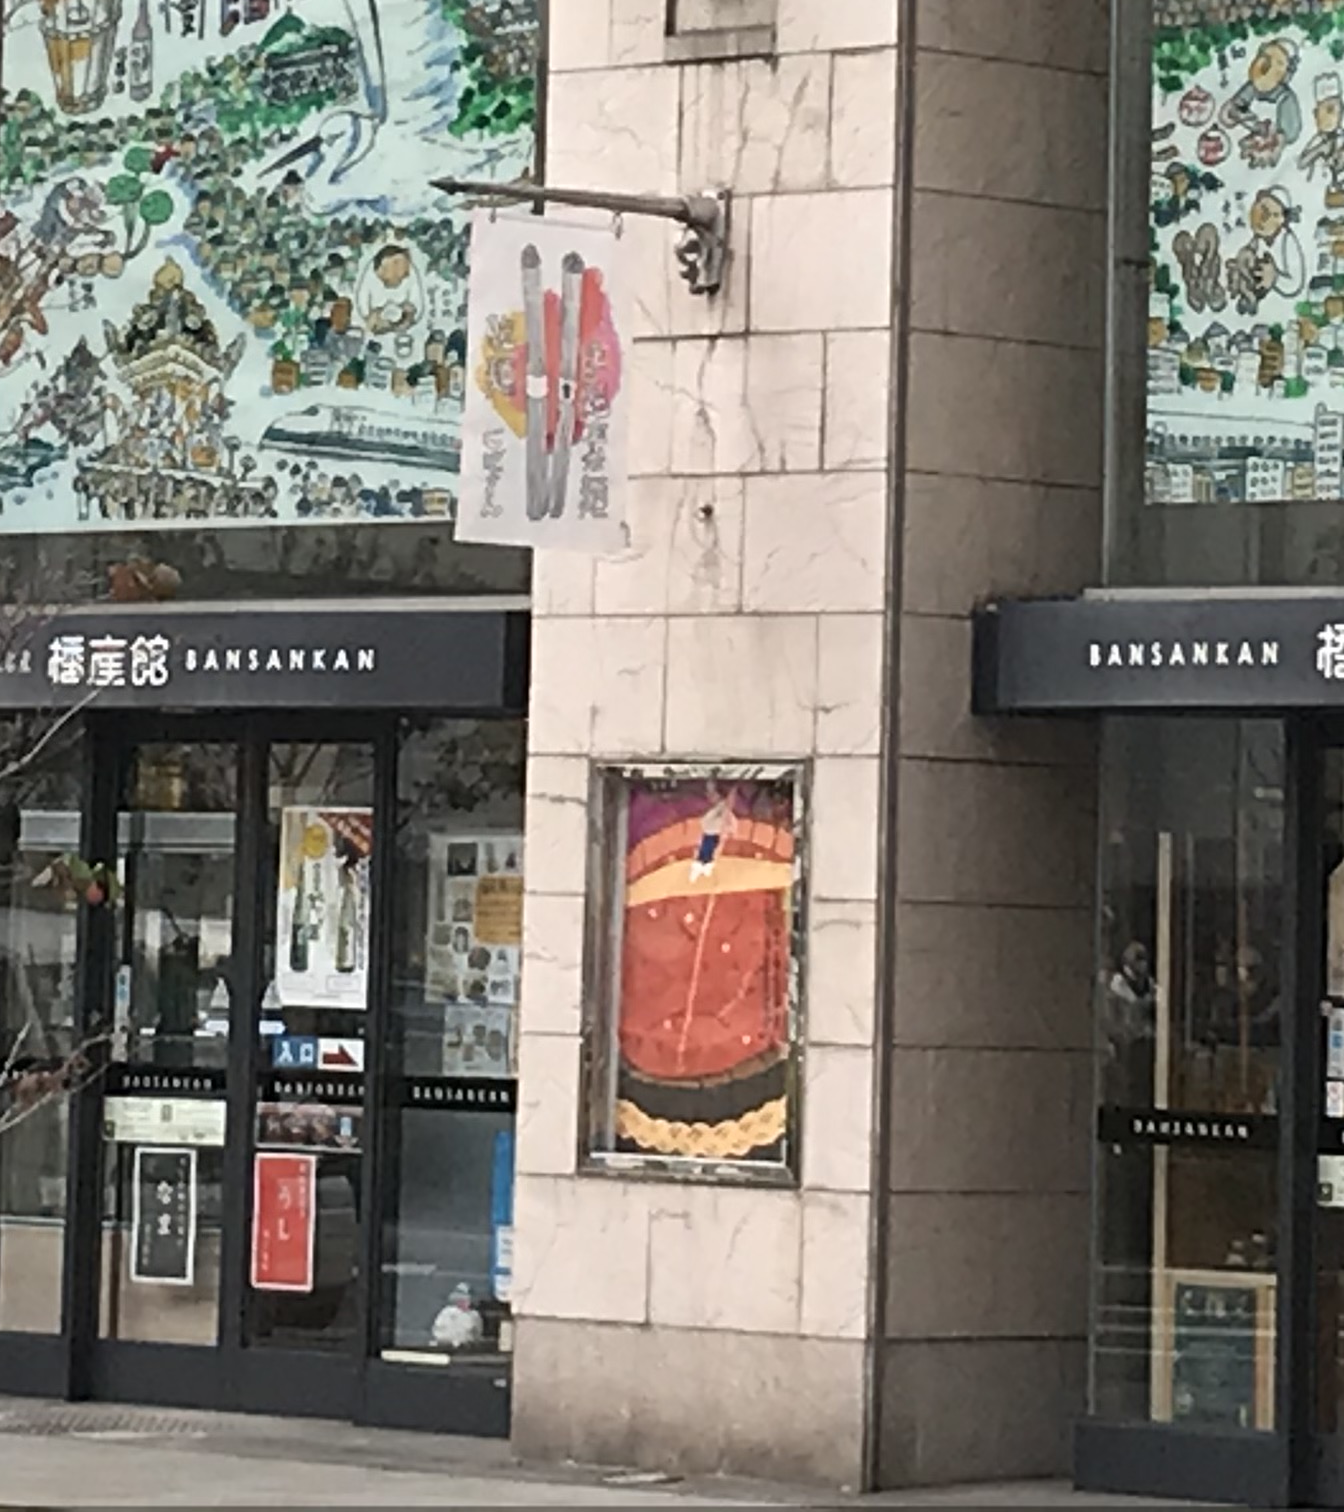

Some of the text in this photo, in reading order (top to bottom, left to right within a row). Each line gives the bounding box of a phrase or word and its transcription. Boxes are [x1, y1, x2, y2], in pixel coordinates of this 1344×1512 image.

[185, 648, 376, 672] BANSANKAN
[1089, 641, 1279, 667] BANSANKAN
[276, 1039, 315, 1065] 入口
